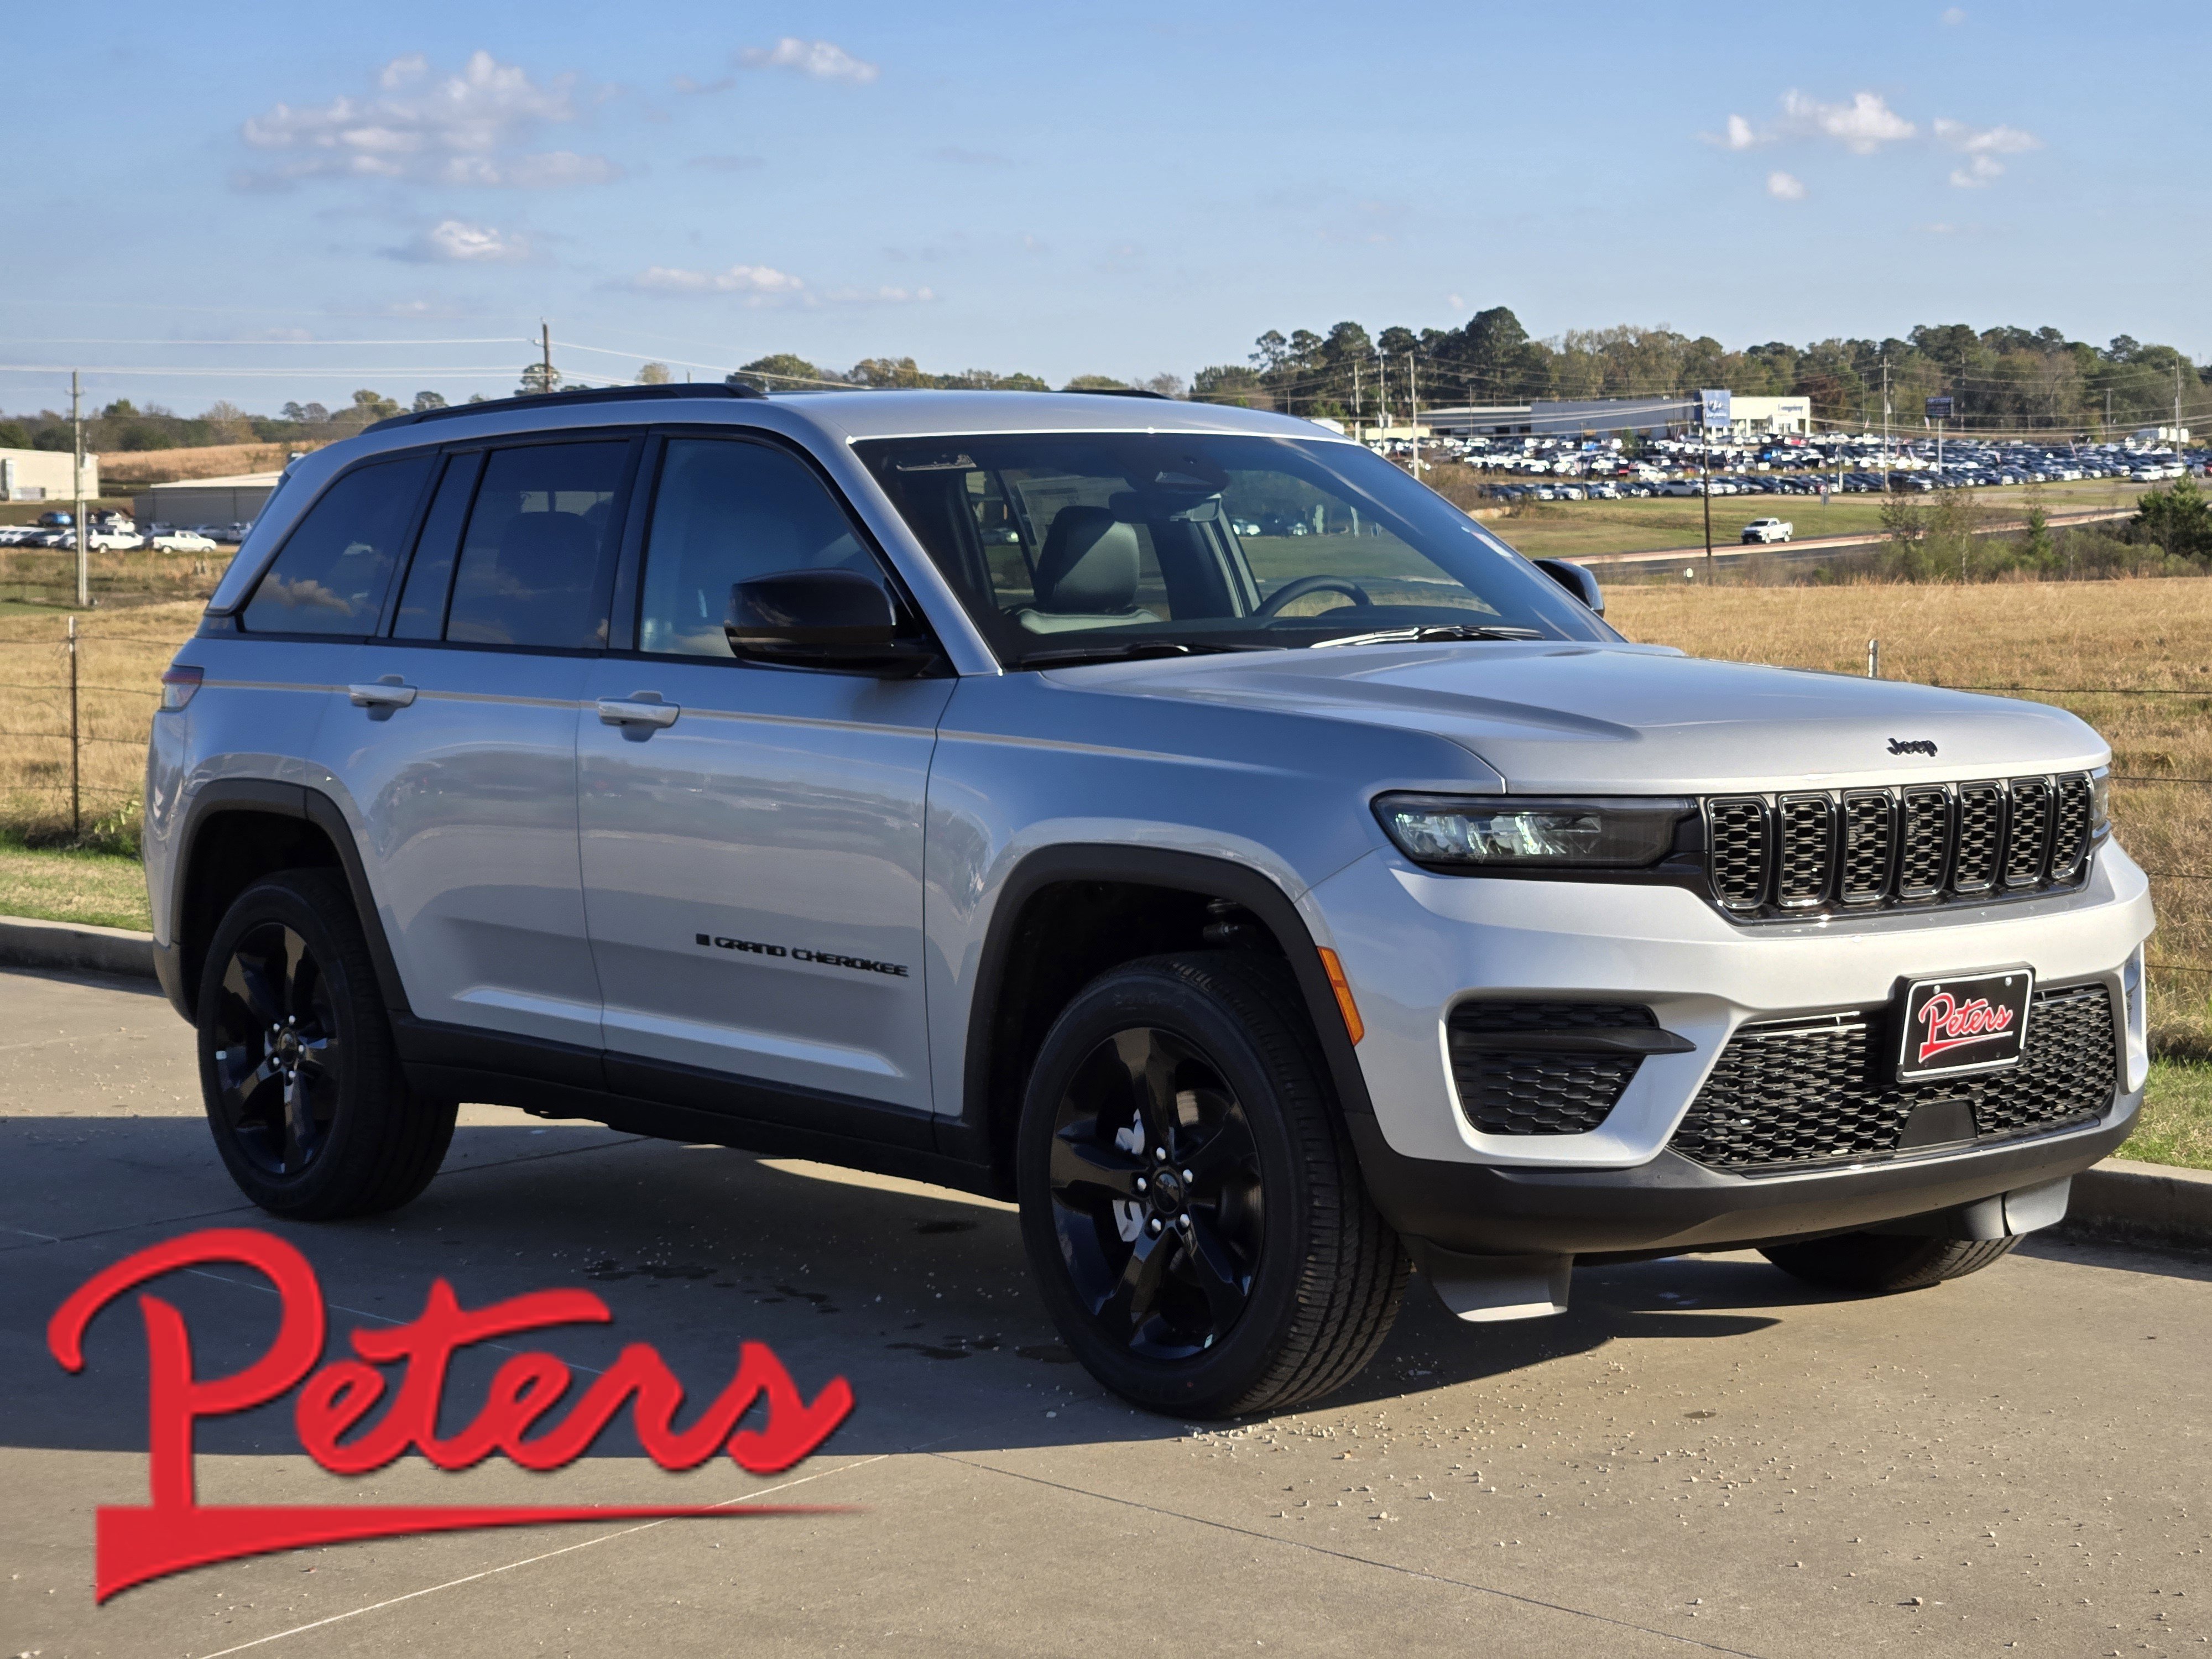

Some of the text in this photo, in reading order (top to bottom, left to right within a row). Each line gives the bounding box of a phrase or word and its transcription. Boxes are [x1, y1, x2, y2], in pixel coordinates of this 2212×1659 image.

[1886, 737, 1938, 757] Jeep
[714, 936, 910, 978] GRAND CHEROKEE
[1918, 992, 2013, 1059] Peters
